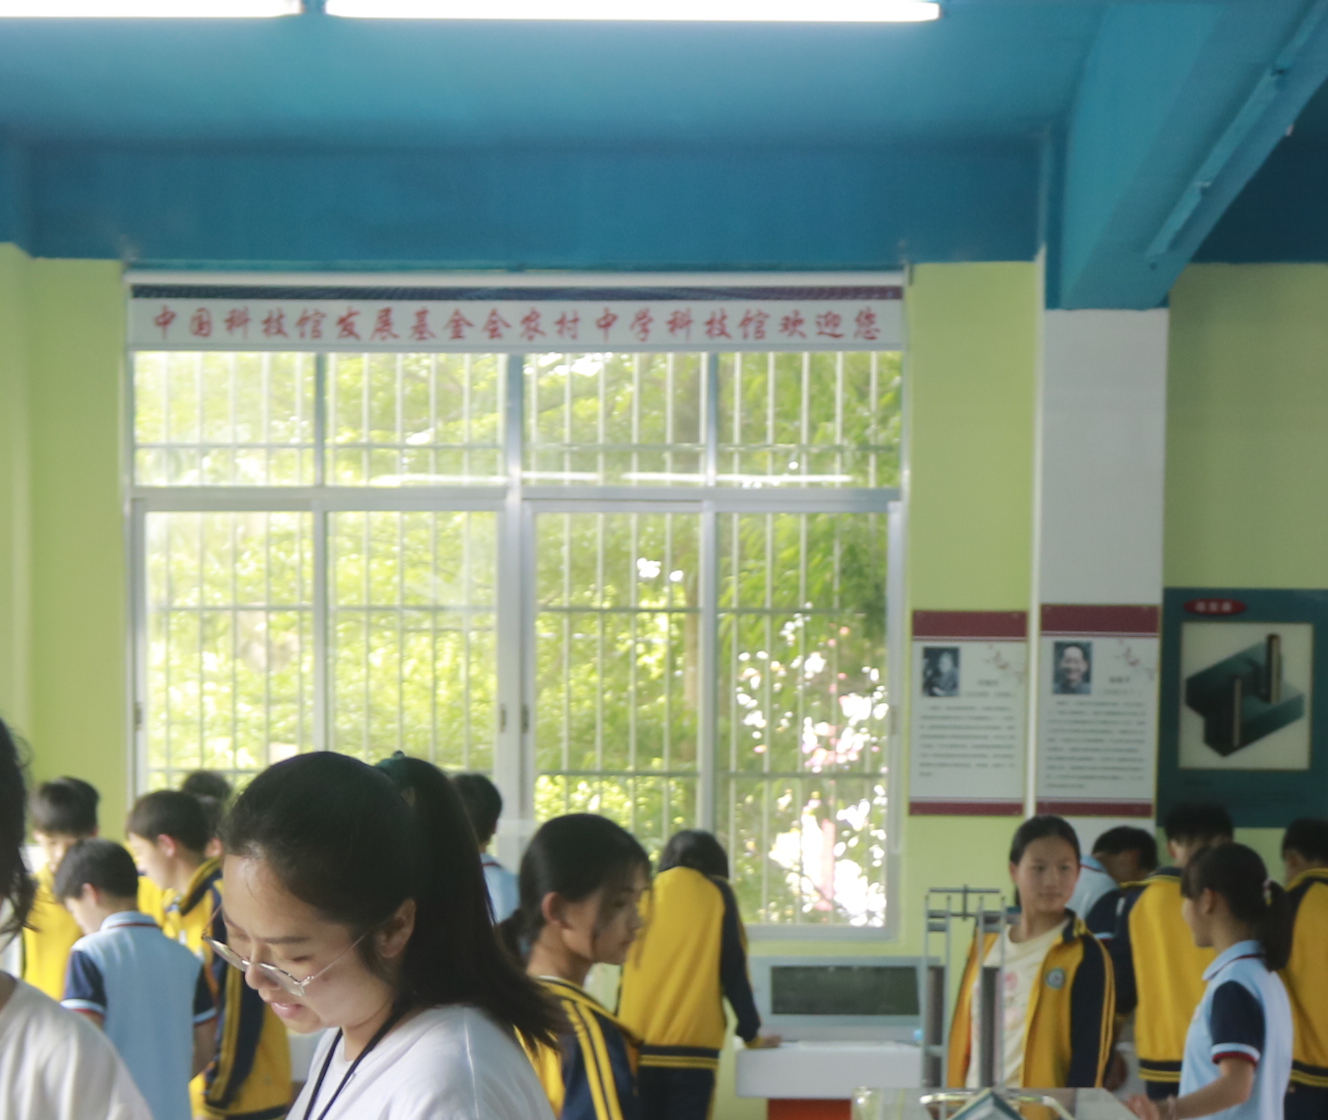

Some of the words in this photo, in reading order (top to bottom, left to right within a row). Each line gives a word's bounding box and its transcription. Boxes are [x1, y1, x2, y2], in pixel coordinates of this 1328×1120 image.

[153, 307, 882, 342] 中国科技馆发展基金会农村中学科技馆欢迎您
